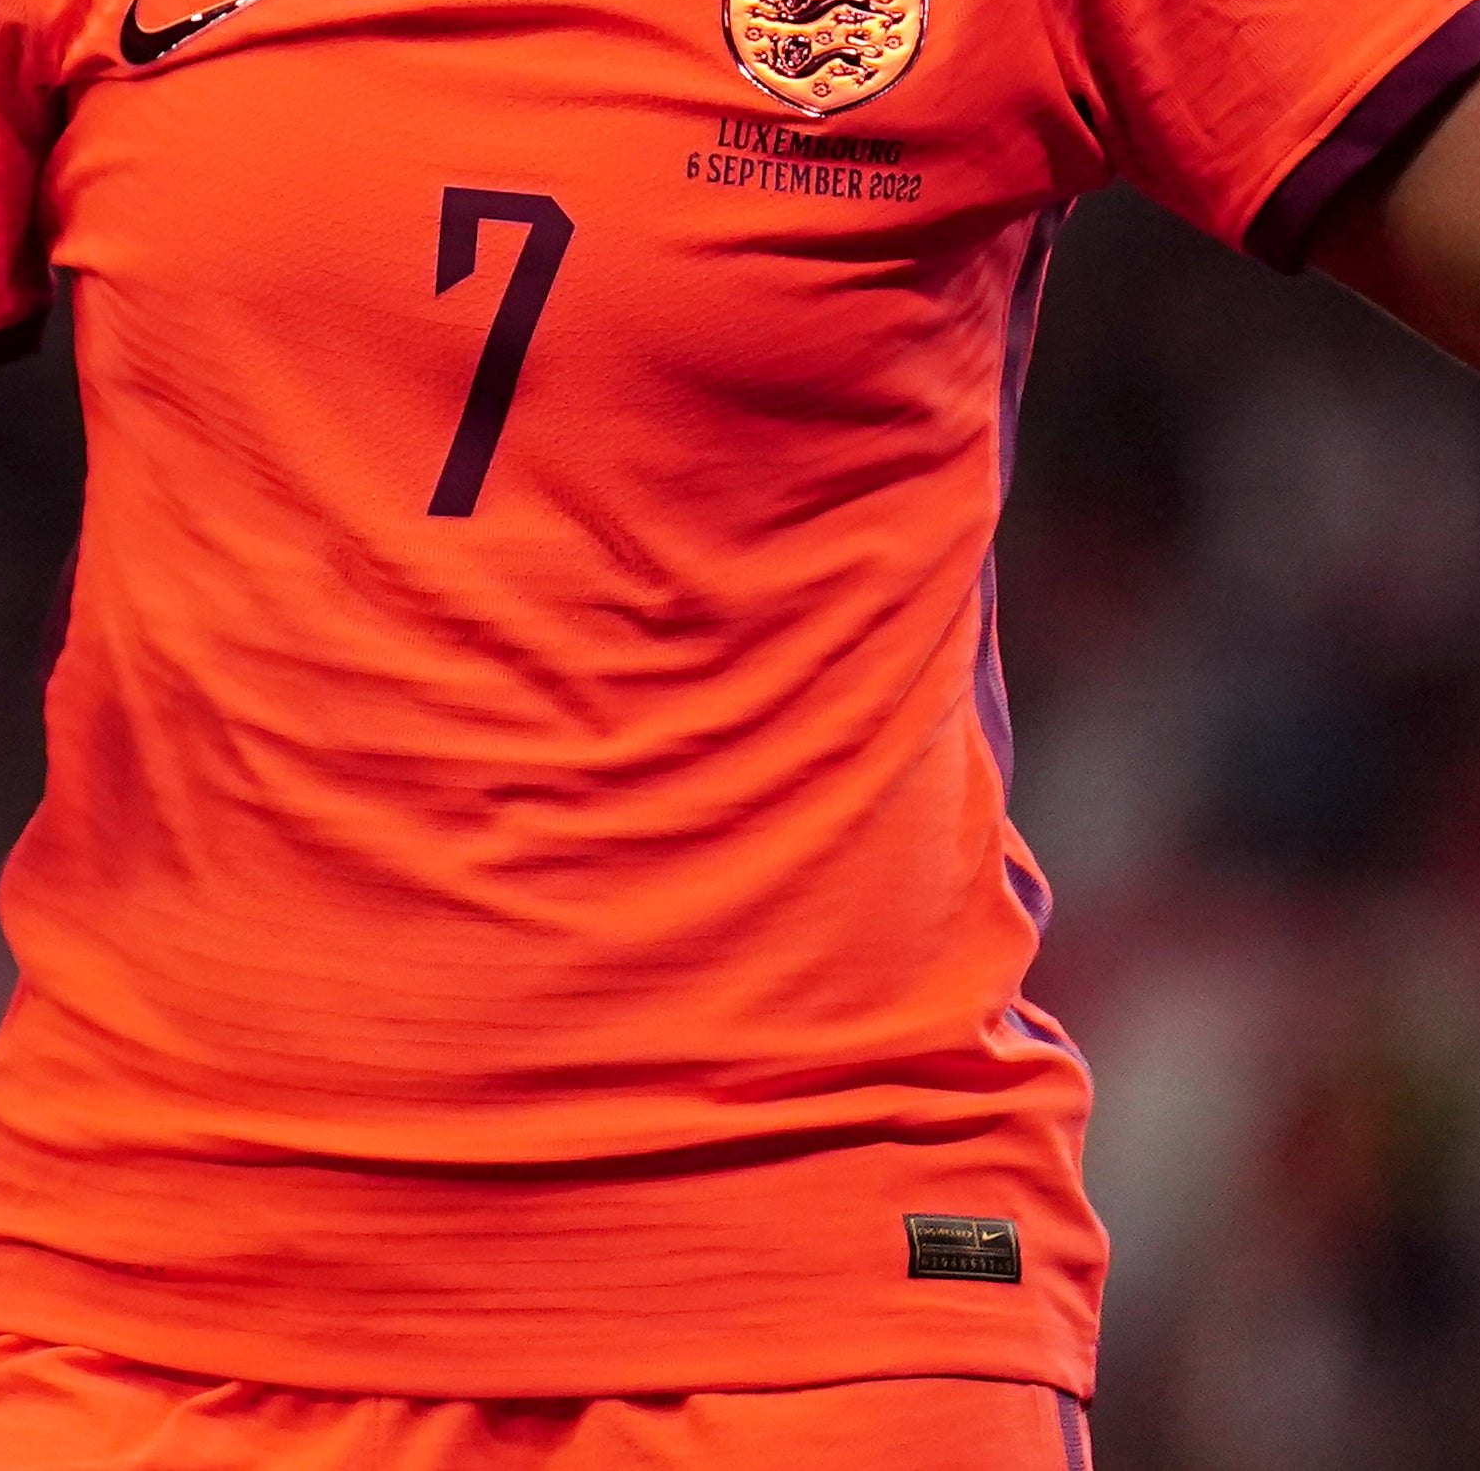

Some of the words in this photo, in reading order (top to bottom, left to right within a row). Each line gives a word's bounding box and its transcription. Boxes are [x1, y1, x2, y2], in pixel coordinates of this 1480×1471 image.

[718, 118, 903, 165] LUXEMBOURG
[686, 152, 701, 180] 6
[706, 153, 863, 199] SEPTEMBER
[868, 171, 922, 203] 2022
[427, 186, 575, 517] 7
